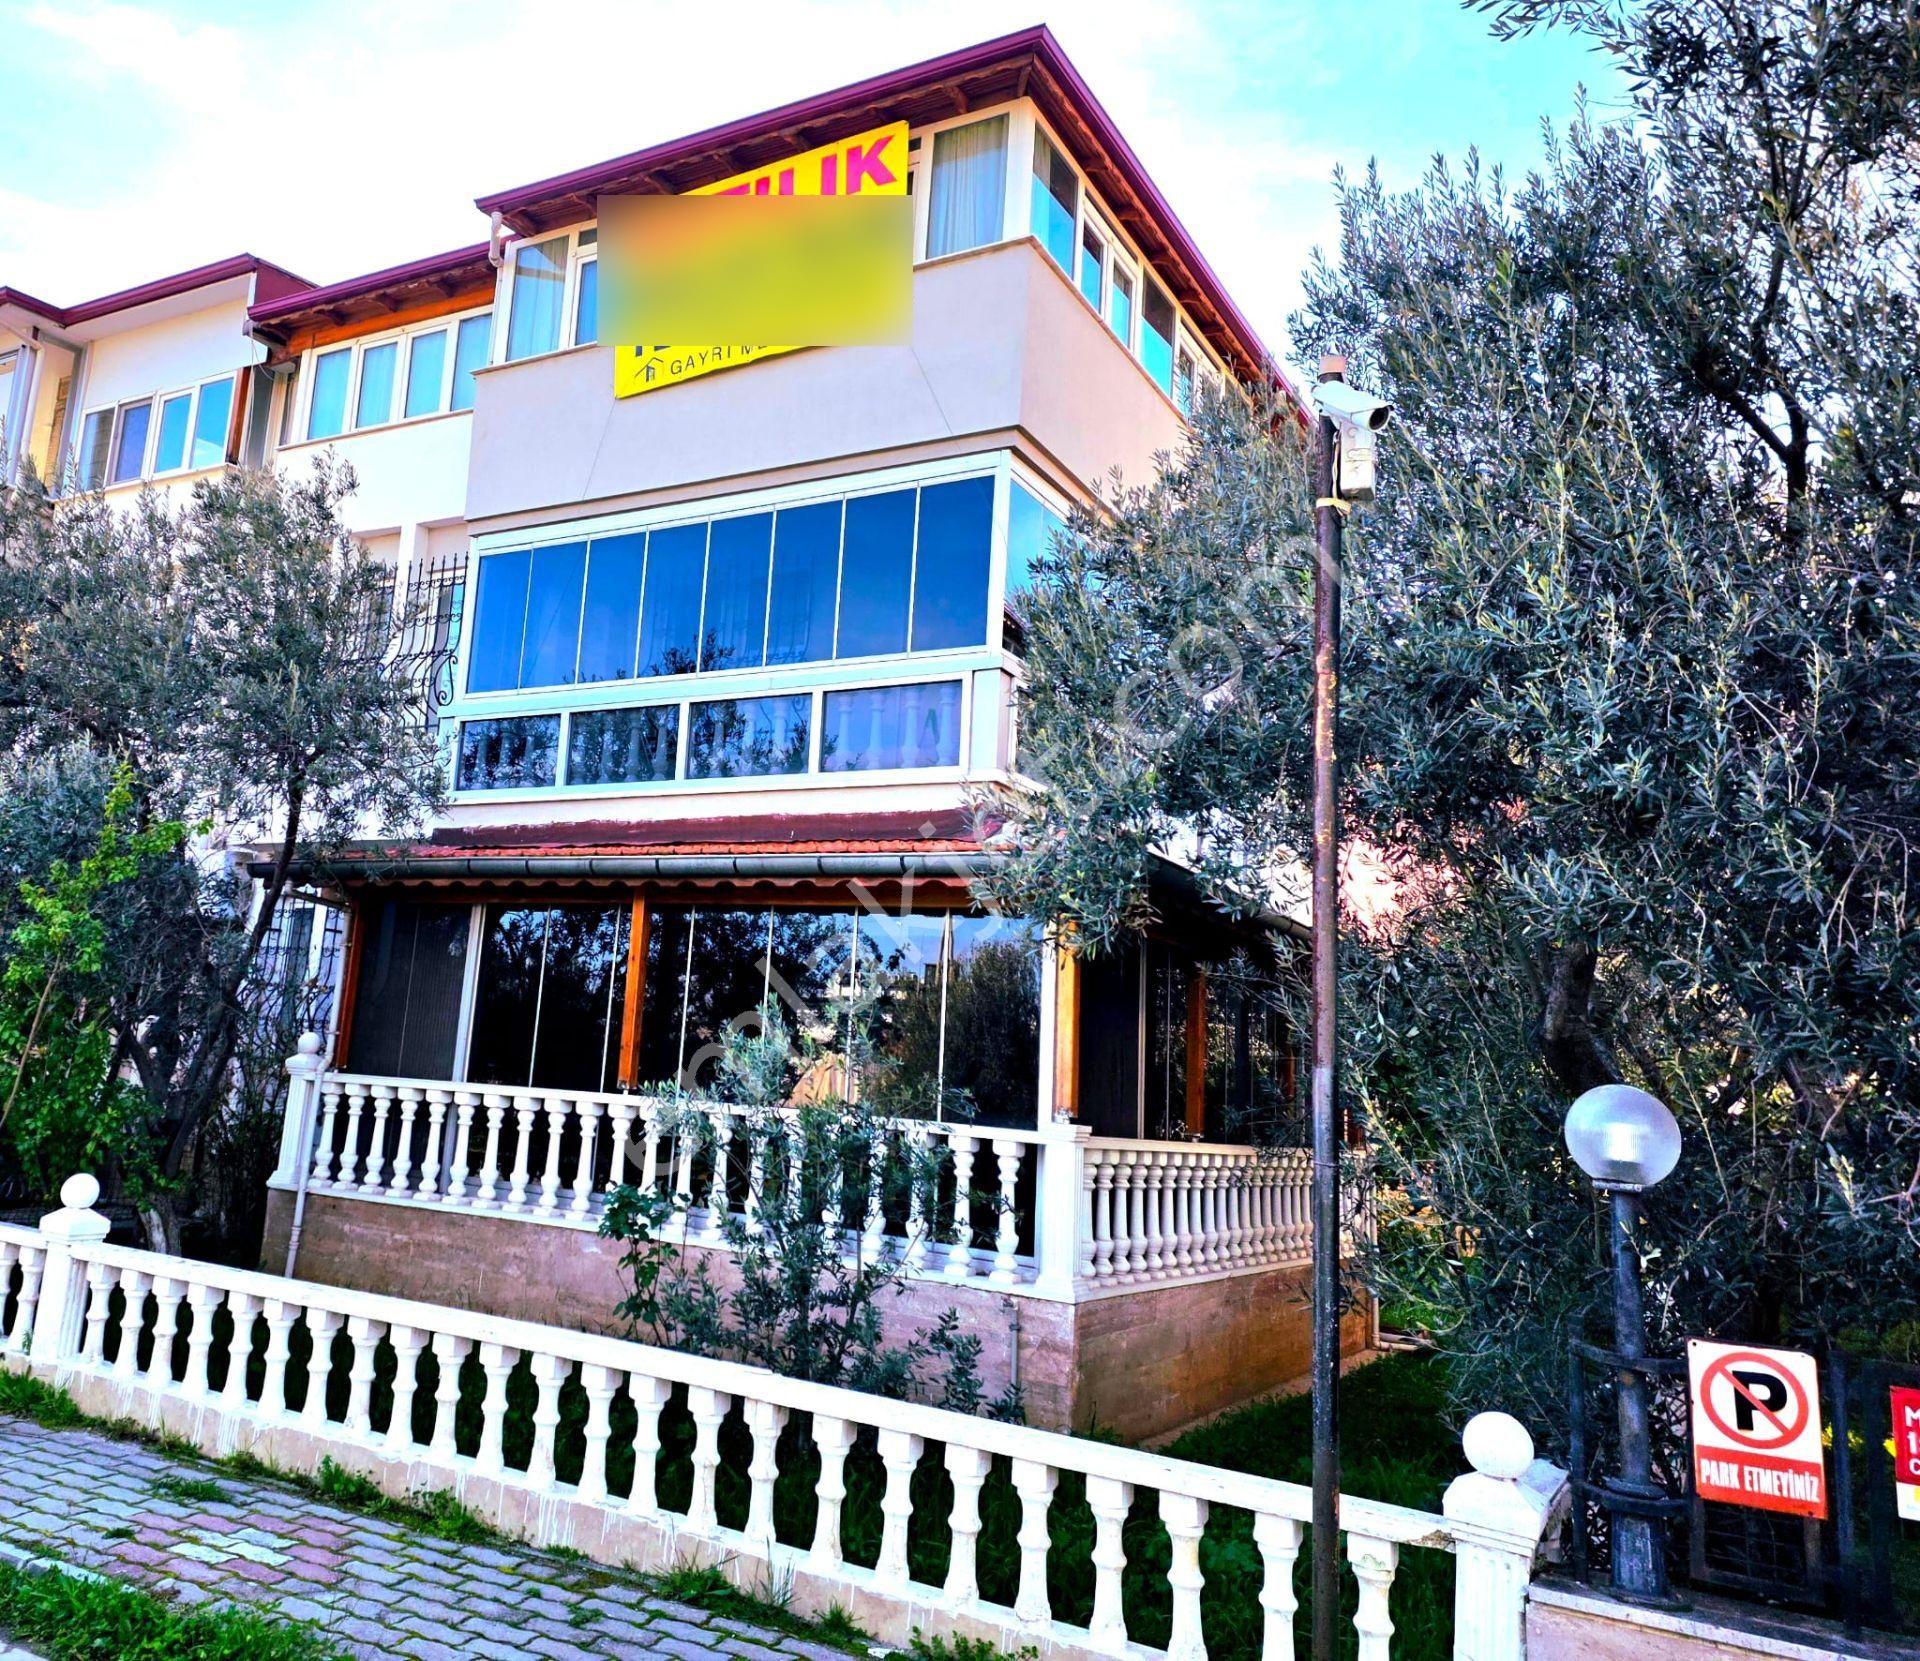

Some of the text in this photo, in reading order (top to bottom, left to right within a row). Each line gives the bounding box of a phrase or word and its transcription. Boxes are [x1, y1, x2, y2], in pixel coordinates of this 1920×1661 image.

[1732, 1370, 1788, 1431] P
[1700, 1458, 1820, 1503] PARK ETMEYİNİZ
